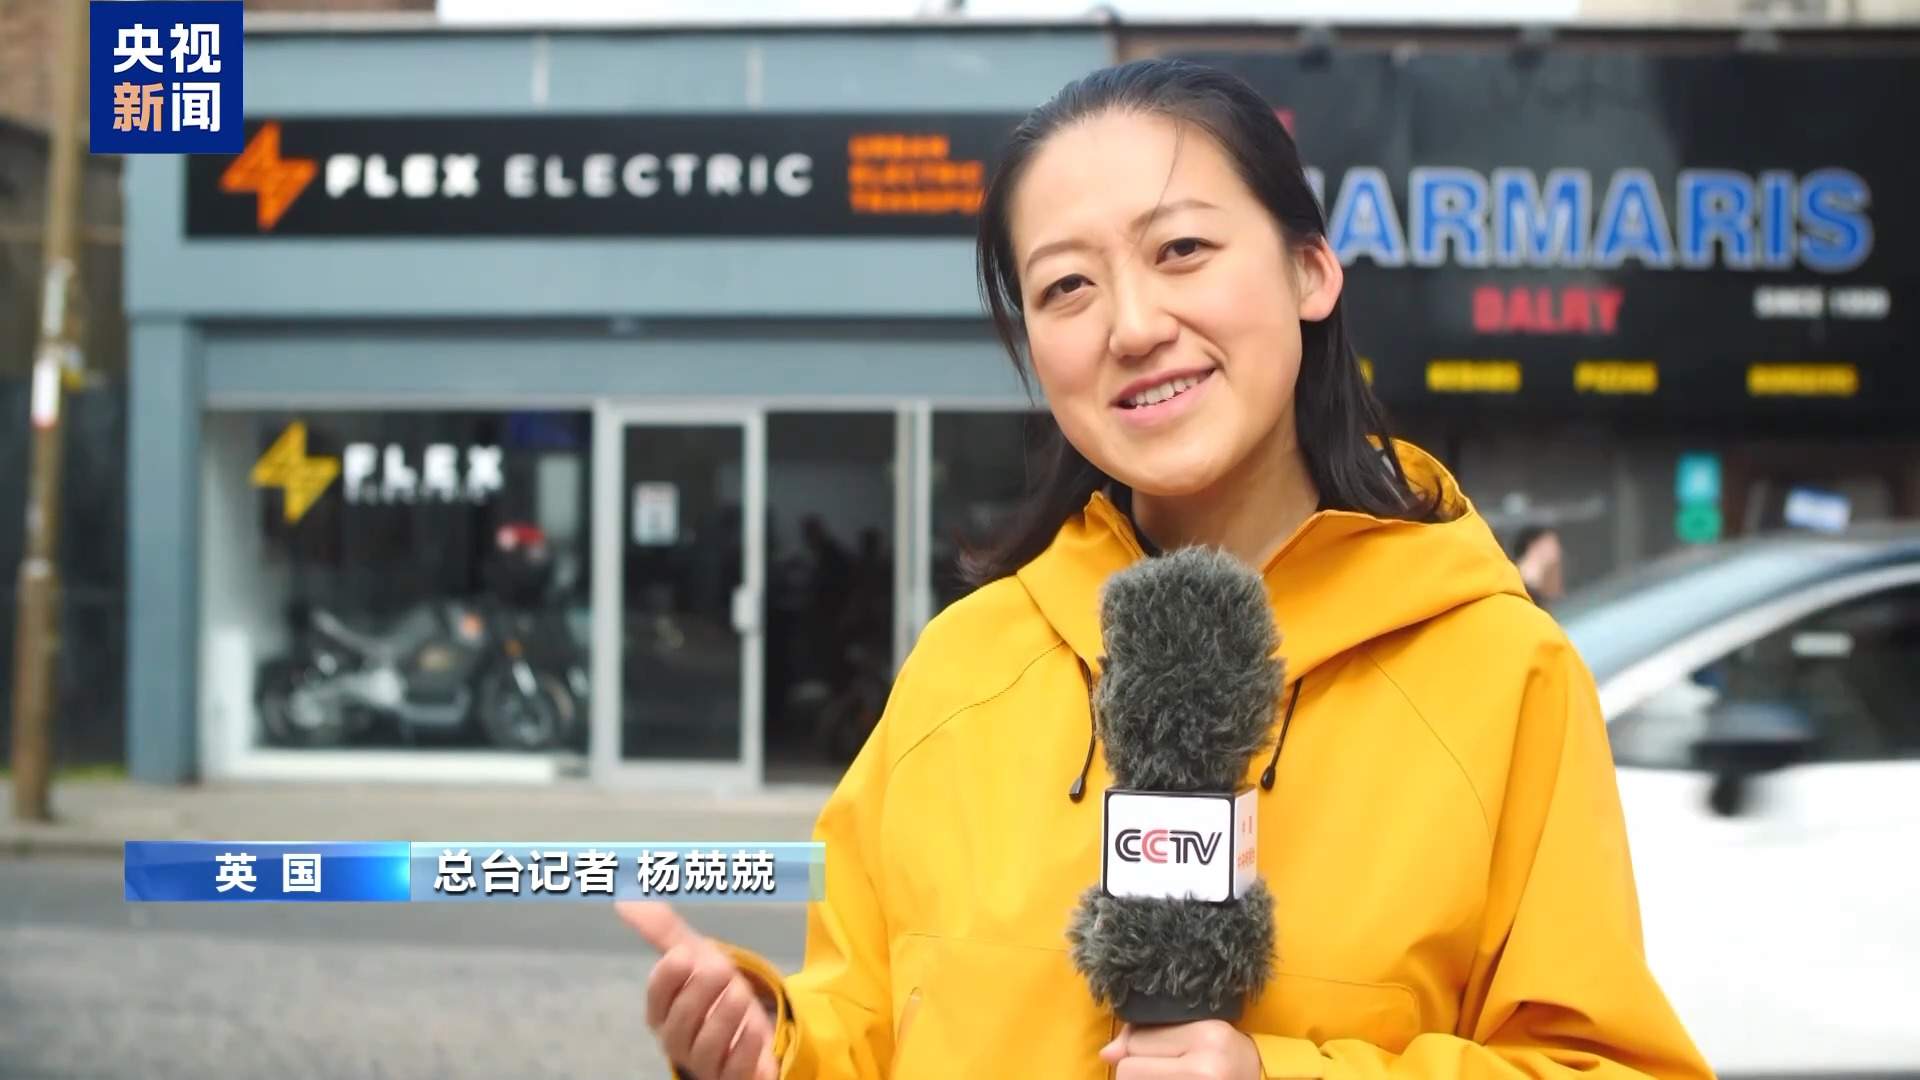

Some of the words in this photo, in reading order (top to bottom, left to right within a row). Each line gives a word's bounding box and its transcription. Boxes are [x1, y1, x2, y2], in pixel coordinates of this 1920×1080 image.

[325, 153, 480, 198] FLEX
[504, 153, 812, 198] ELECTRIC
[1302, 166, 1872, 270] ARMARIS
[343, 442, 503, 492] FLEX
[1114, 828, 1223, 866] CCTV
